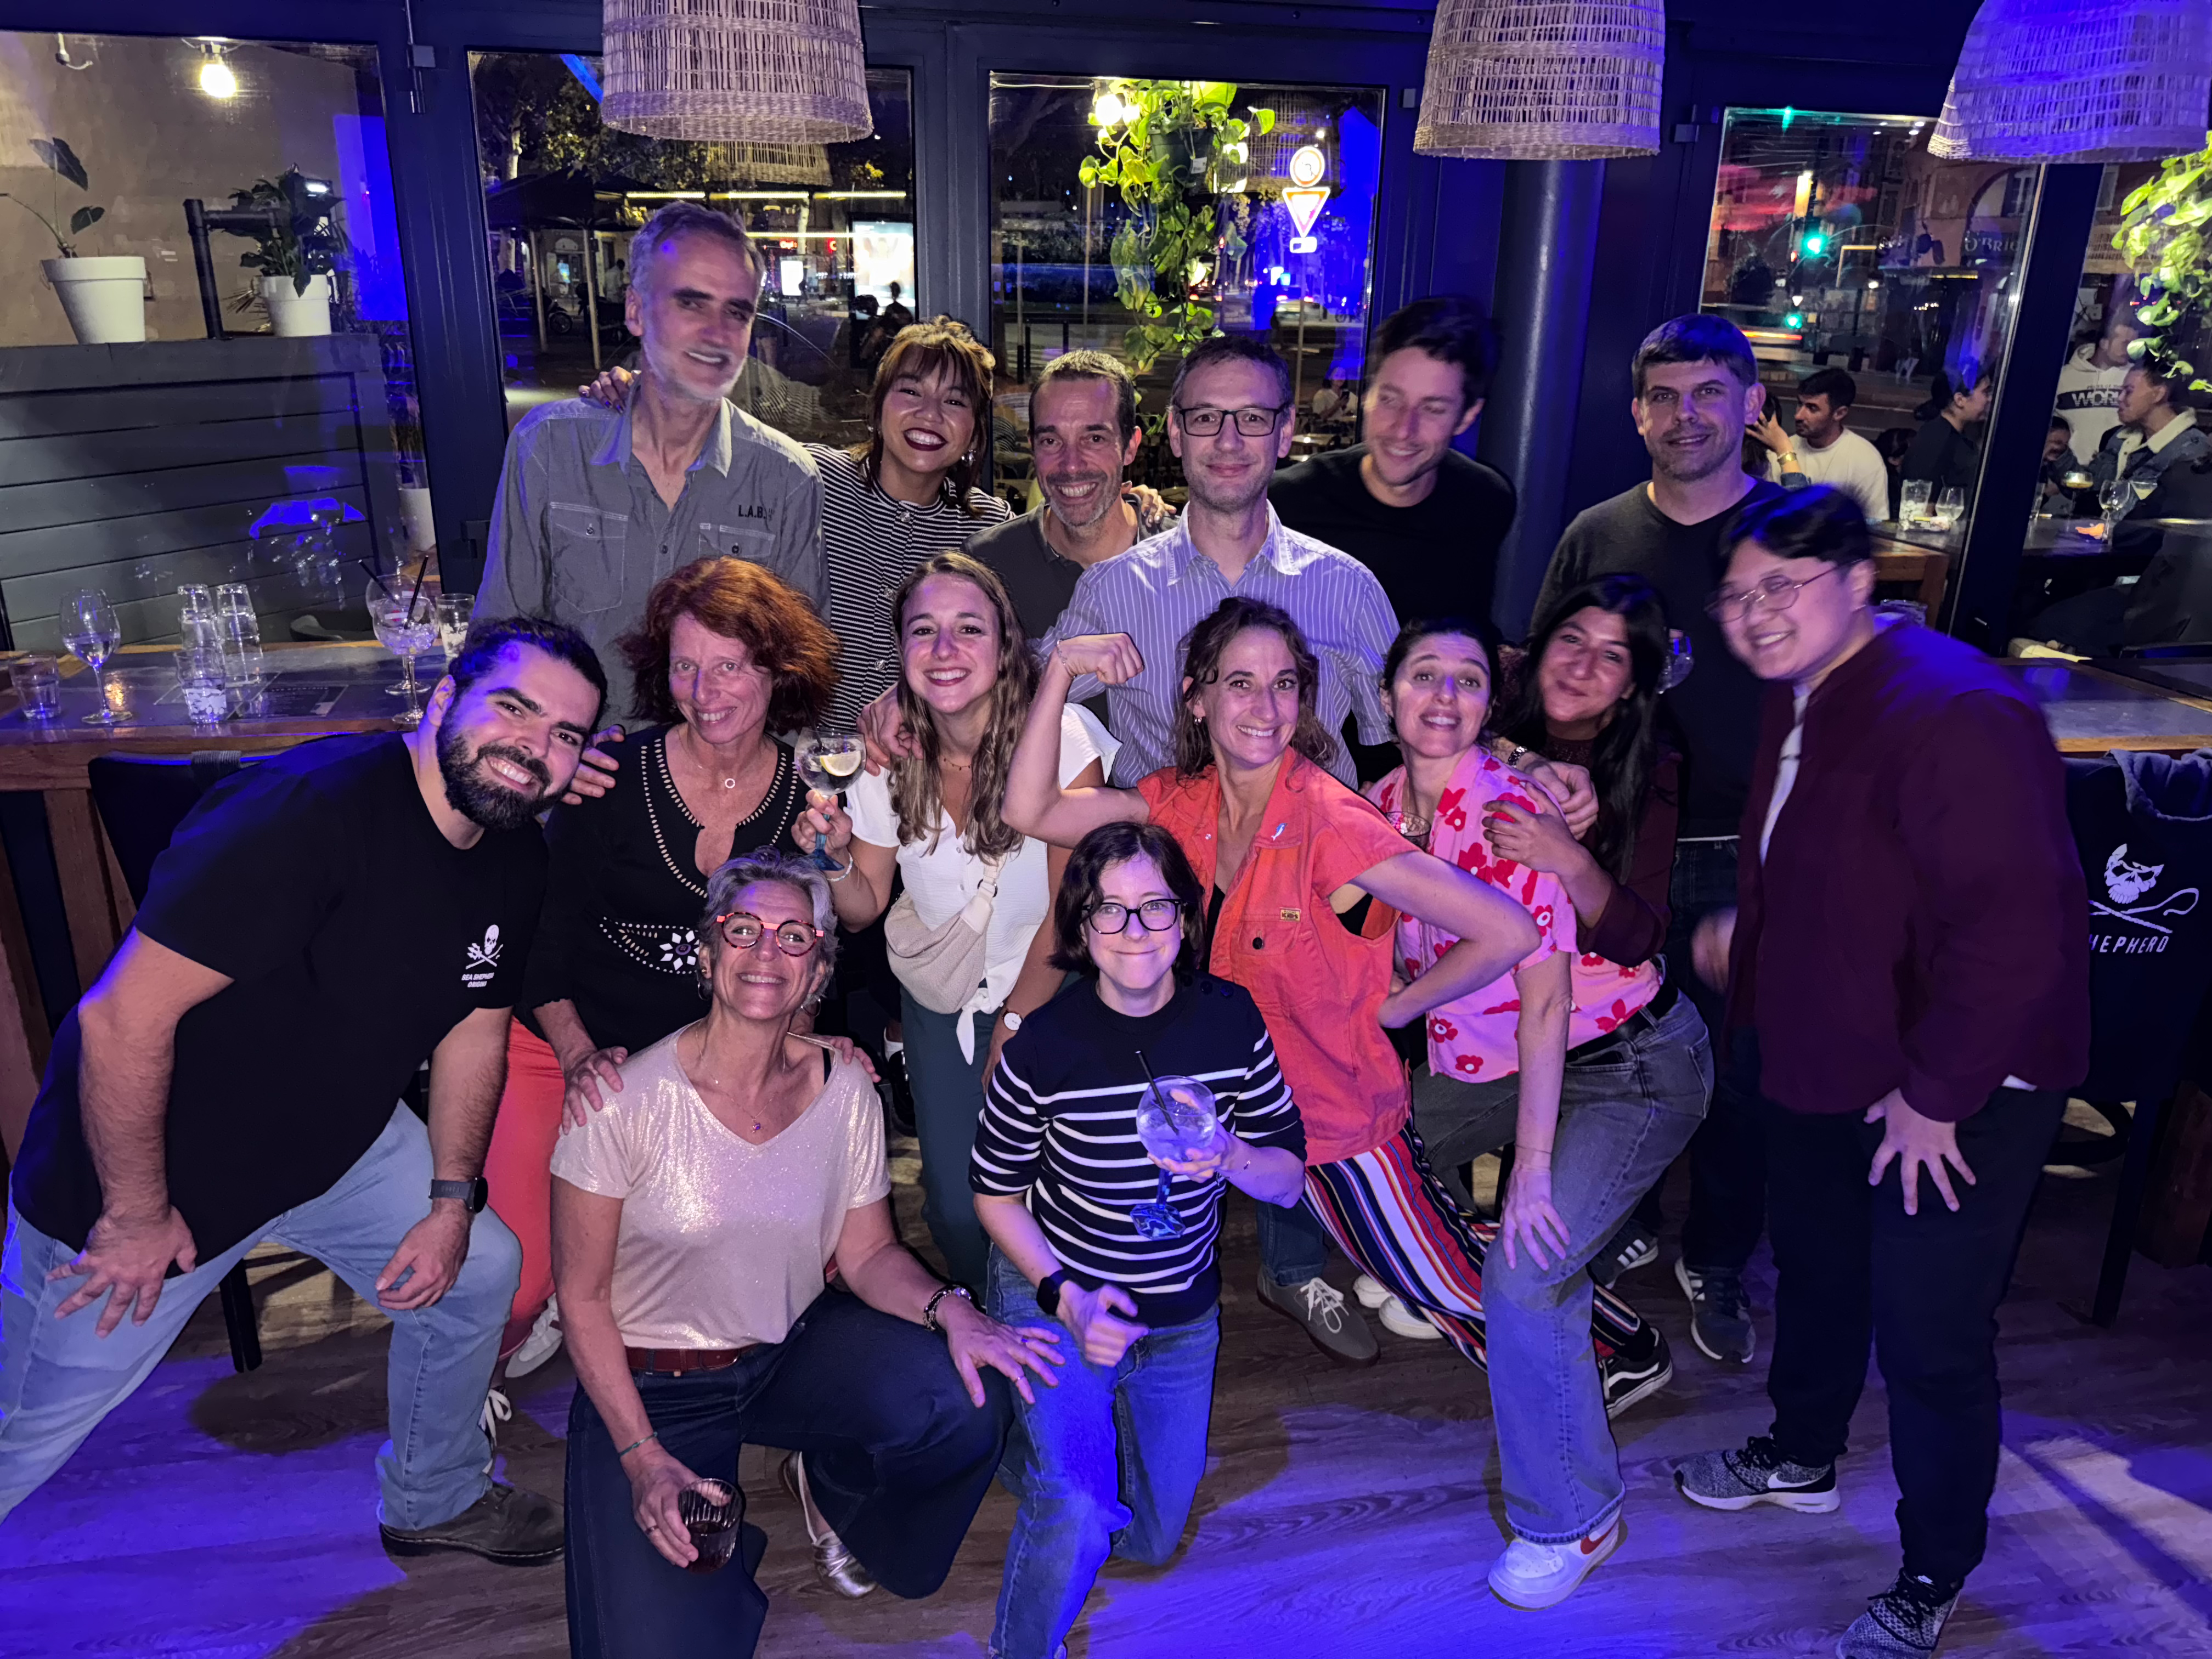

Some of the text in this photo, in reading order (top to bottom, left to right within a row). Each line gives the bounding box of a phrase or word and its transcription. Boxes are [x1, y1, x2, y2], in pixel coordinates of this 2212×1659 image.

[2072, 390, 2119, 407] WORL
[738, 505, 766, 519] L.A.B.
[2089, 934, 2170, 953] HEPHERD
